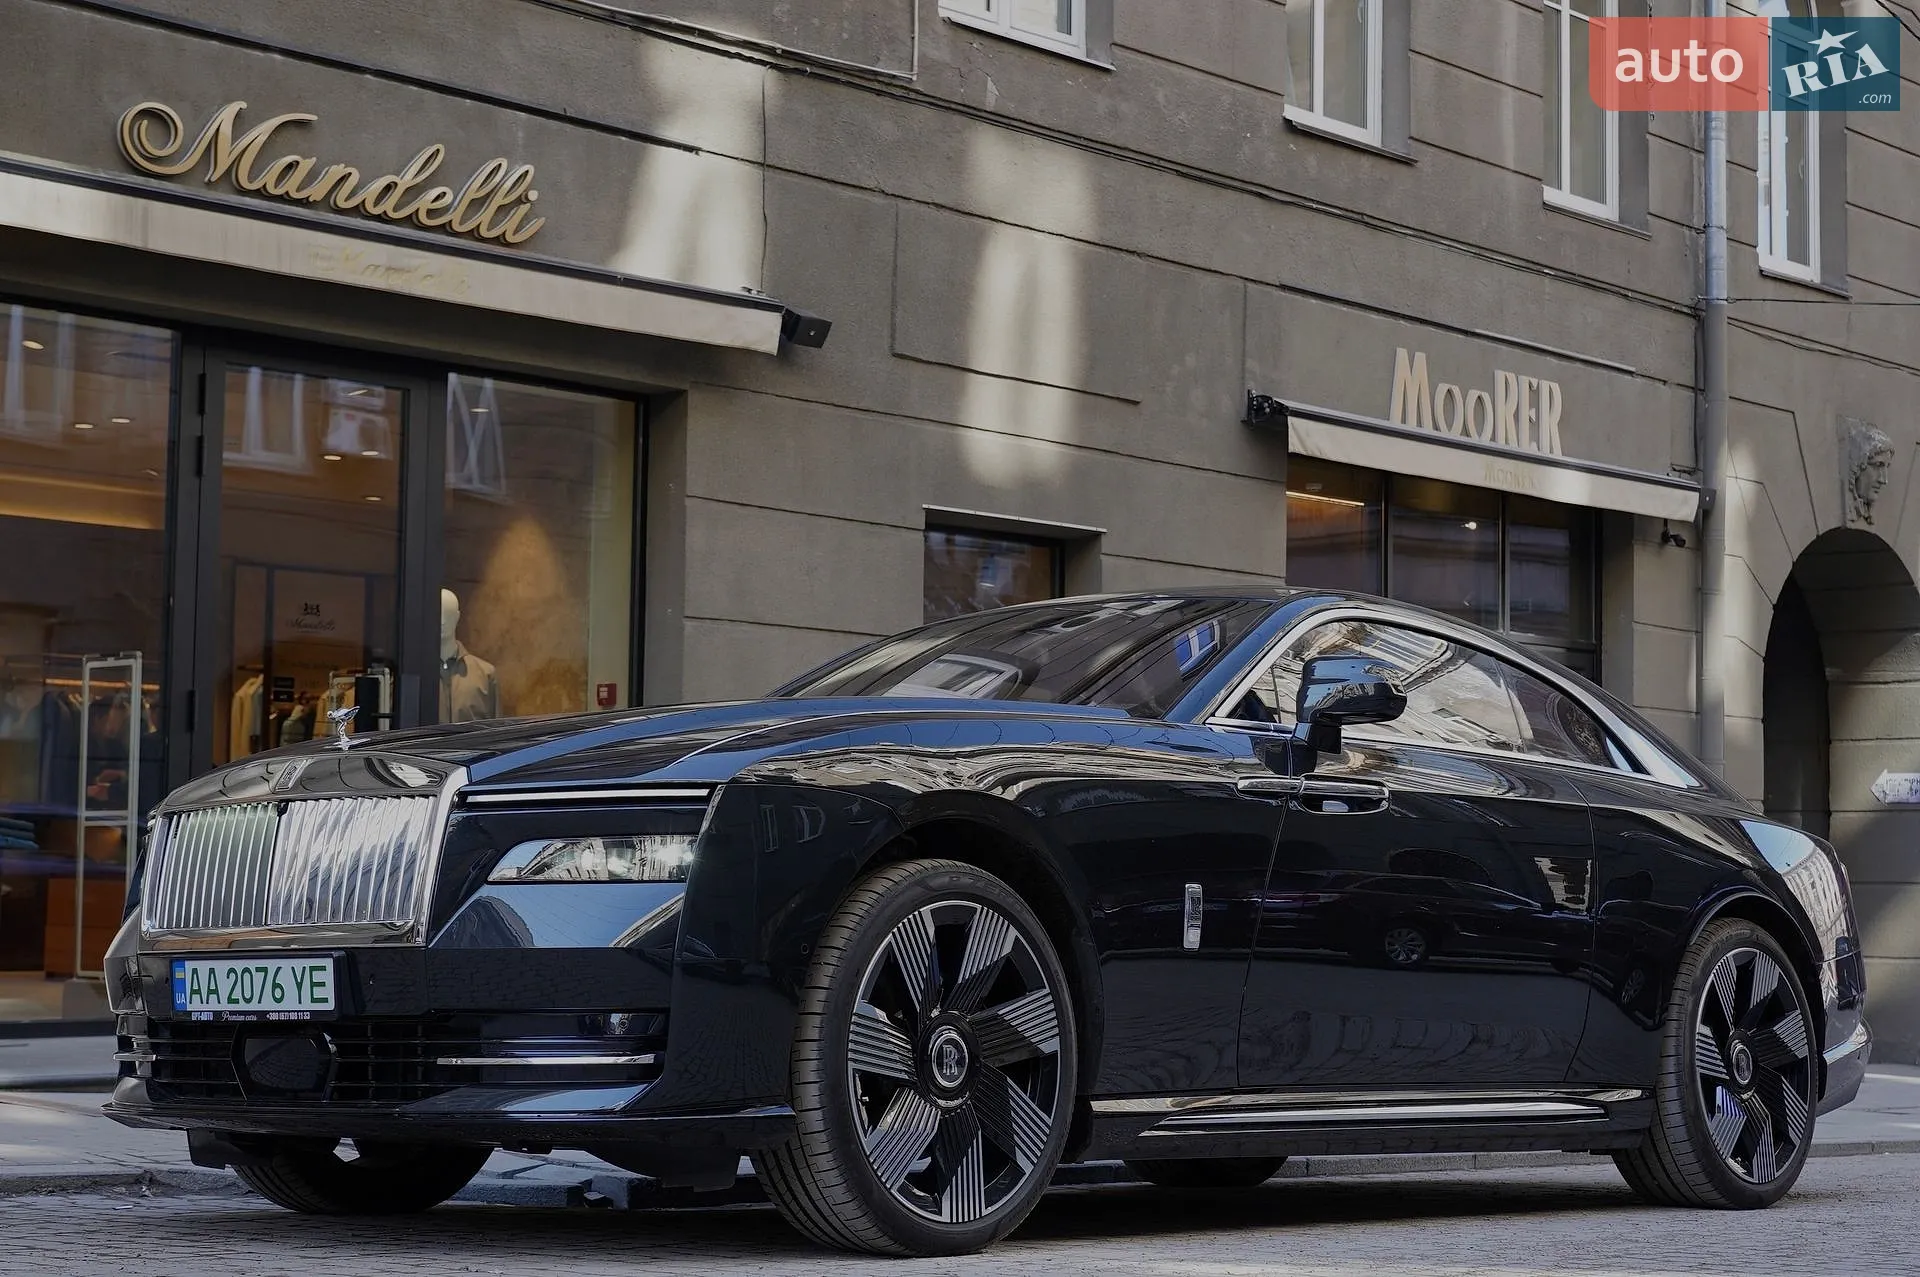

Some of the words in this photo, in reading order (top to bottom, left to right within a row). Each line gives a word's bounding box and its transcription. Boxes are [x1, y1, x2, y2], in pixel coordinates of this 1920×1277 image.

[116, 101, 546, 244] Mandelli
[176, 994, 186, 1004] UA
[189, 967, 221, 1005] AA
[226, 966, 285, 1005] 2076
[291, 965, 329, 1004] YE
